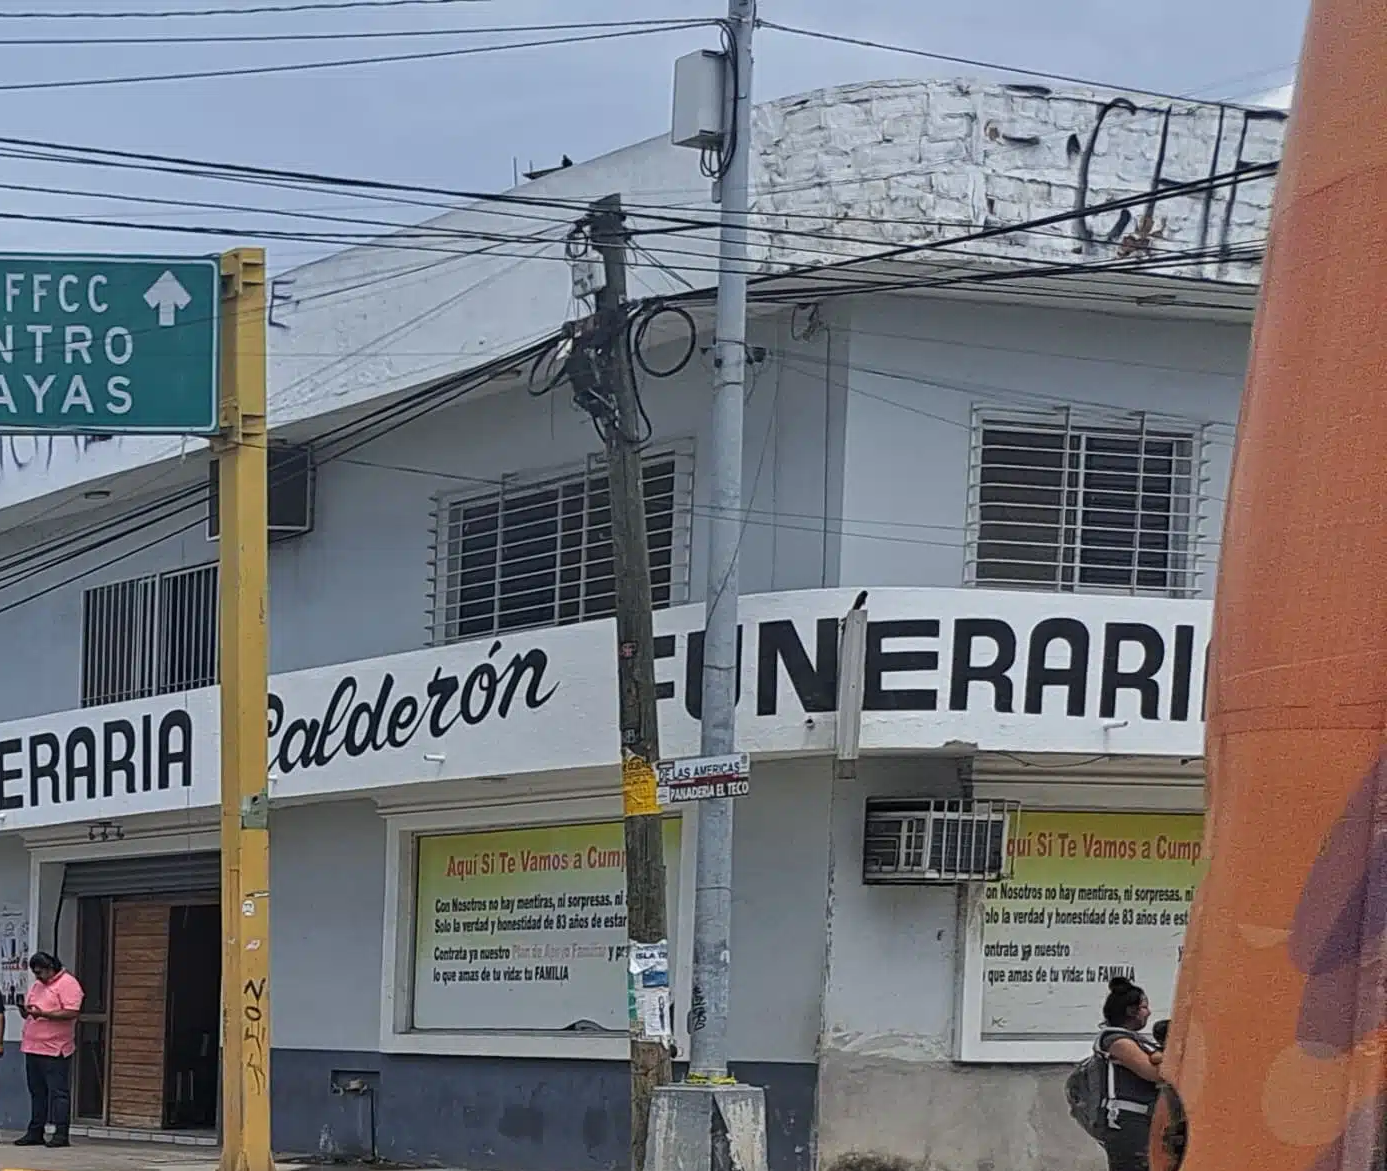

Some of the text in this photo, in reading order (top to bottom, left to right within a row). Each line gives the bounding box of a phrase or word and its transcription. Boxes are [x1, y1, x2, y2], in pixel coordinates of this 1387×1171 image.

[6, 273, 109, 314] FFCC
[716, 783, 726, 798] EL
[728, 781, 749, 795] TECO
[1037, 832, 1052, 857] Si
[1058, 833, 1077, 857] Te
[1082, 833, 1136, 859] Vamos
[1141, 840, 1151, 859] a
[481, 853, 495, 874] Si
[499, 852, 516, 874] Te
[521, 850, 569, 872] Vamos
[573, 852, 582, 869] a
[435, 898, 450, 913] Con
[452, 898, 487, 912] Nosotros
[489, 899, 499, 911] no
[501, 896, 515, 914] hay
[517, 894, 555, 911] mentiras,
[557, 893, 566, 908] ni
[615, 890, 624, 906] ni
[1000, 883, 1042, 900] Nosotros
[1045, 887, 1058, 900] no
[1060, 884, 1076, 904] hay
[1078, 884, 1121, 904] mentiras,
[1124, 884, 1133, 900] ni
[435, 918, 451, 933] Solo
[453, 918, 461, 932] la
[462, 916, 489, 931] verdad
[490, 920, 496, 935] y
[498, 914, 542, 930] honestidad
[544, 914, 554, 929] de
[556, 914, 567, 929] 83
[569, 913, 589, 929] años
[591, 912, 602, 928] de
[1002, 907, 1011, 924] la
[1013, 907, 1045, 924] verdad
[1047, 911, 1054, 928] y
[1055, 907, 1106, 924] honestidad
[1108, 908, 1120, 924] de
[1122, 908, 1134, 925] 83
[1136, 909, 1157, 925] años
[1160, 909, 1172, 925] de
[434, 946, 467, 960] Contrata
[469, 948, 478, 964] ya
[480, 945, 510, 960] nuestro
[1035, 940, 1070, 957] nuestro
[433, 967, 440, 982] lo
[442, 970, 456, 986] que
[458, 969, 479, 982] amas
[481, 966, 490, 981] de
[493, 967, 501, 981] tu
[525, 966, 533, 981] tu
[535, 966, 568, 981] FAMILIA
[988, 970, 1005, 986] que
[1008, 969, 1033, 983] amas
[1036, 967, 1048, 982] de
[1050, 967, 1059, 982] tu
[1087, 967, 1096, 982] tu
